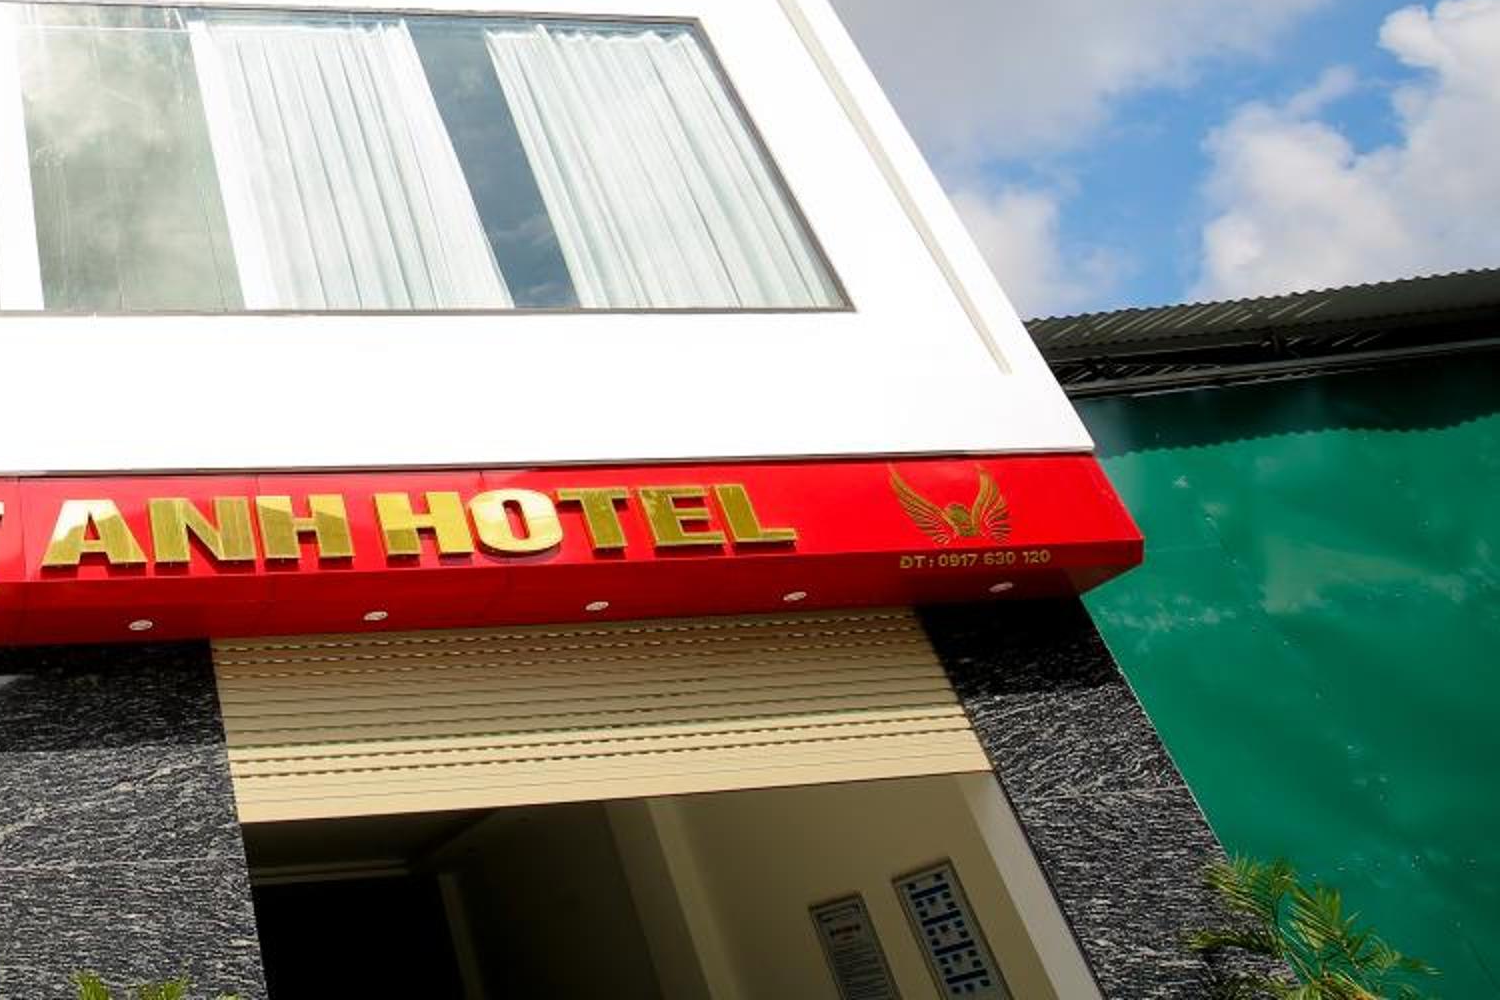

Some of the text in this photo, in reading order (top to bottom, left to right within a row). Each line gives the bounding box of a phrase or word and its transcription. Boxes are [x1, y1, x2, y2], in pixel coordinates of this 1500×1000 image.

[40, 494, 355, 568] ANH
[373, 484, 798, 556] HOTEL
[938, 553, 978, 568] 0917
[983, 551, 1016, 566] 630
[1022, 549, 1051, 564] 120
